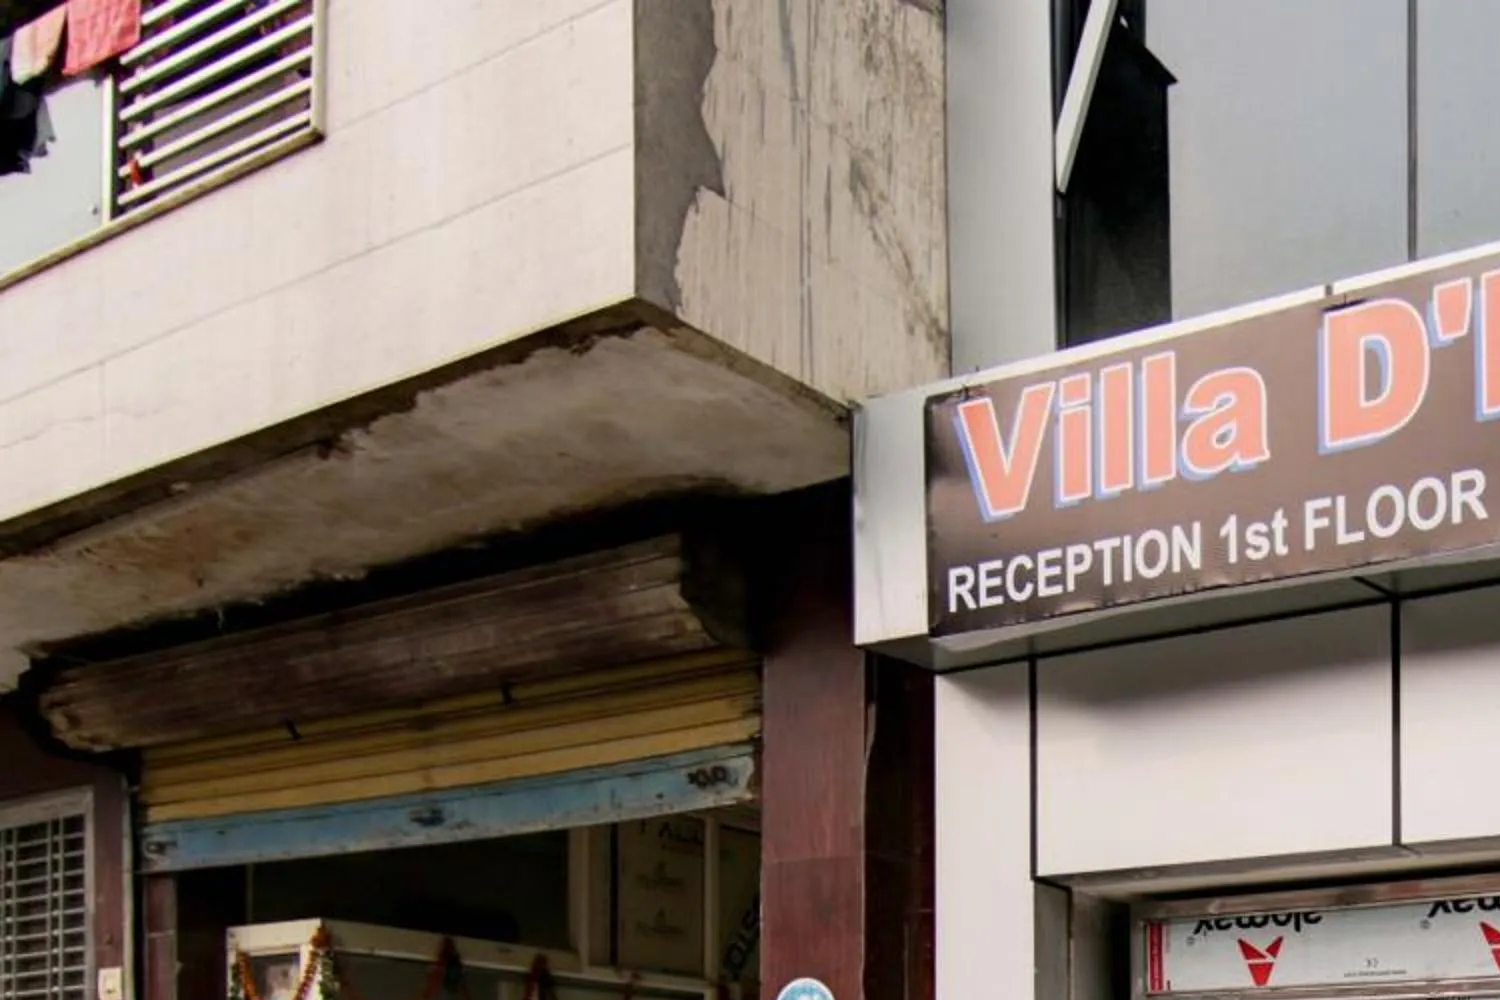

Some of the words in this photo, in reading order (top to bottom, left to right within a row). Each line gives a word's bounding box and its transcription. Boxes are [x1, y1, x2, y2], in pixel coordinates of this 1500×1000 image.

[956, 349, 1271, 522] Villa
[948, 517, 1203, 613] RECEPTION
[1220, 501, 1290, 568] 1st
[1304, 468, 1489, 552] FLOOR
